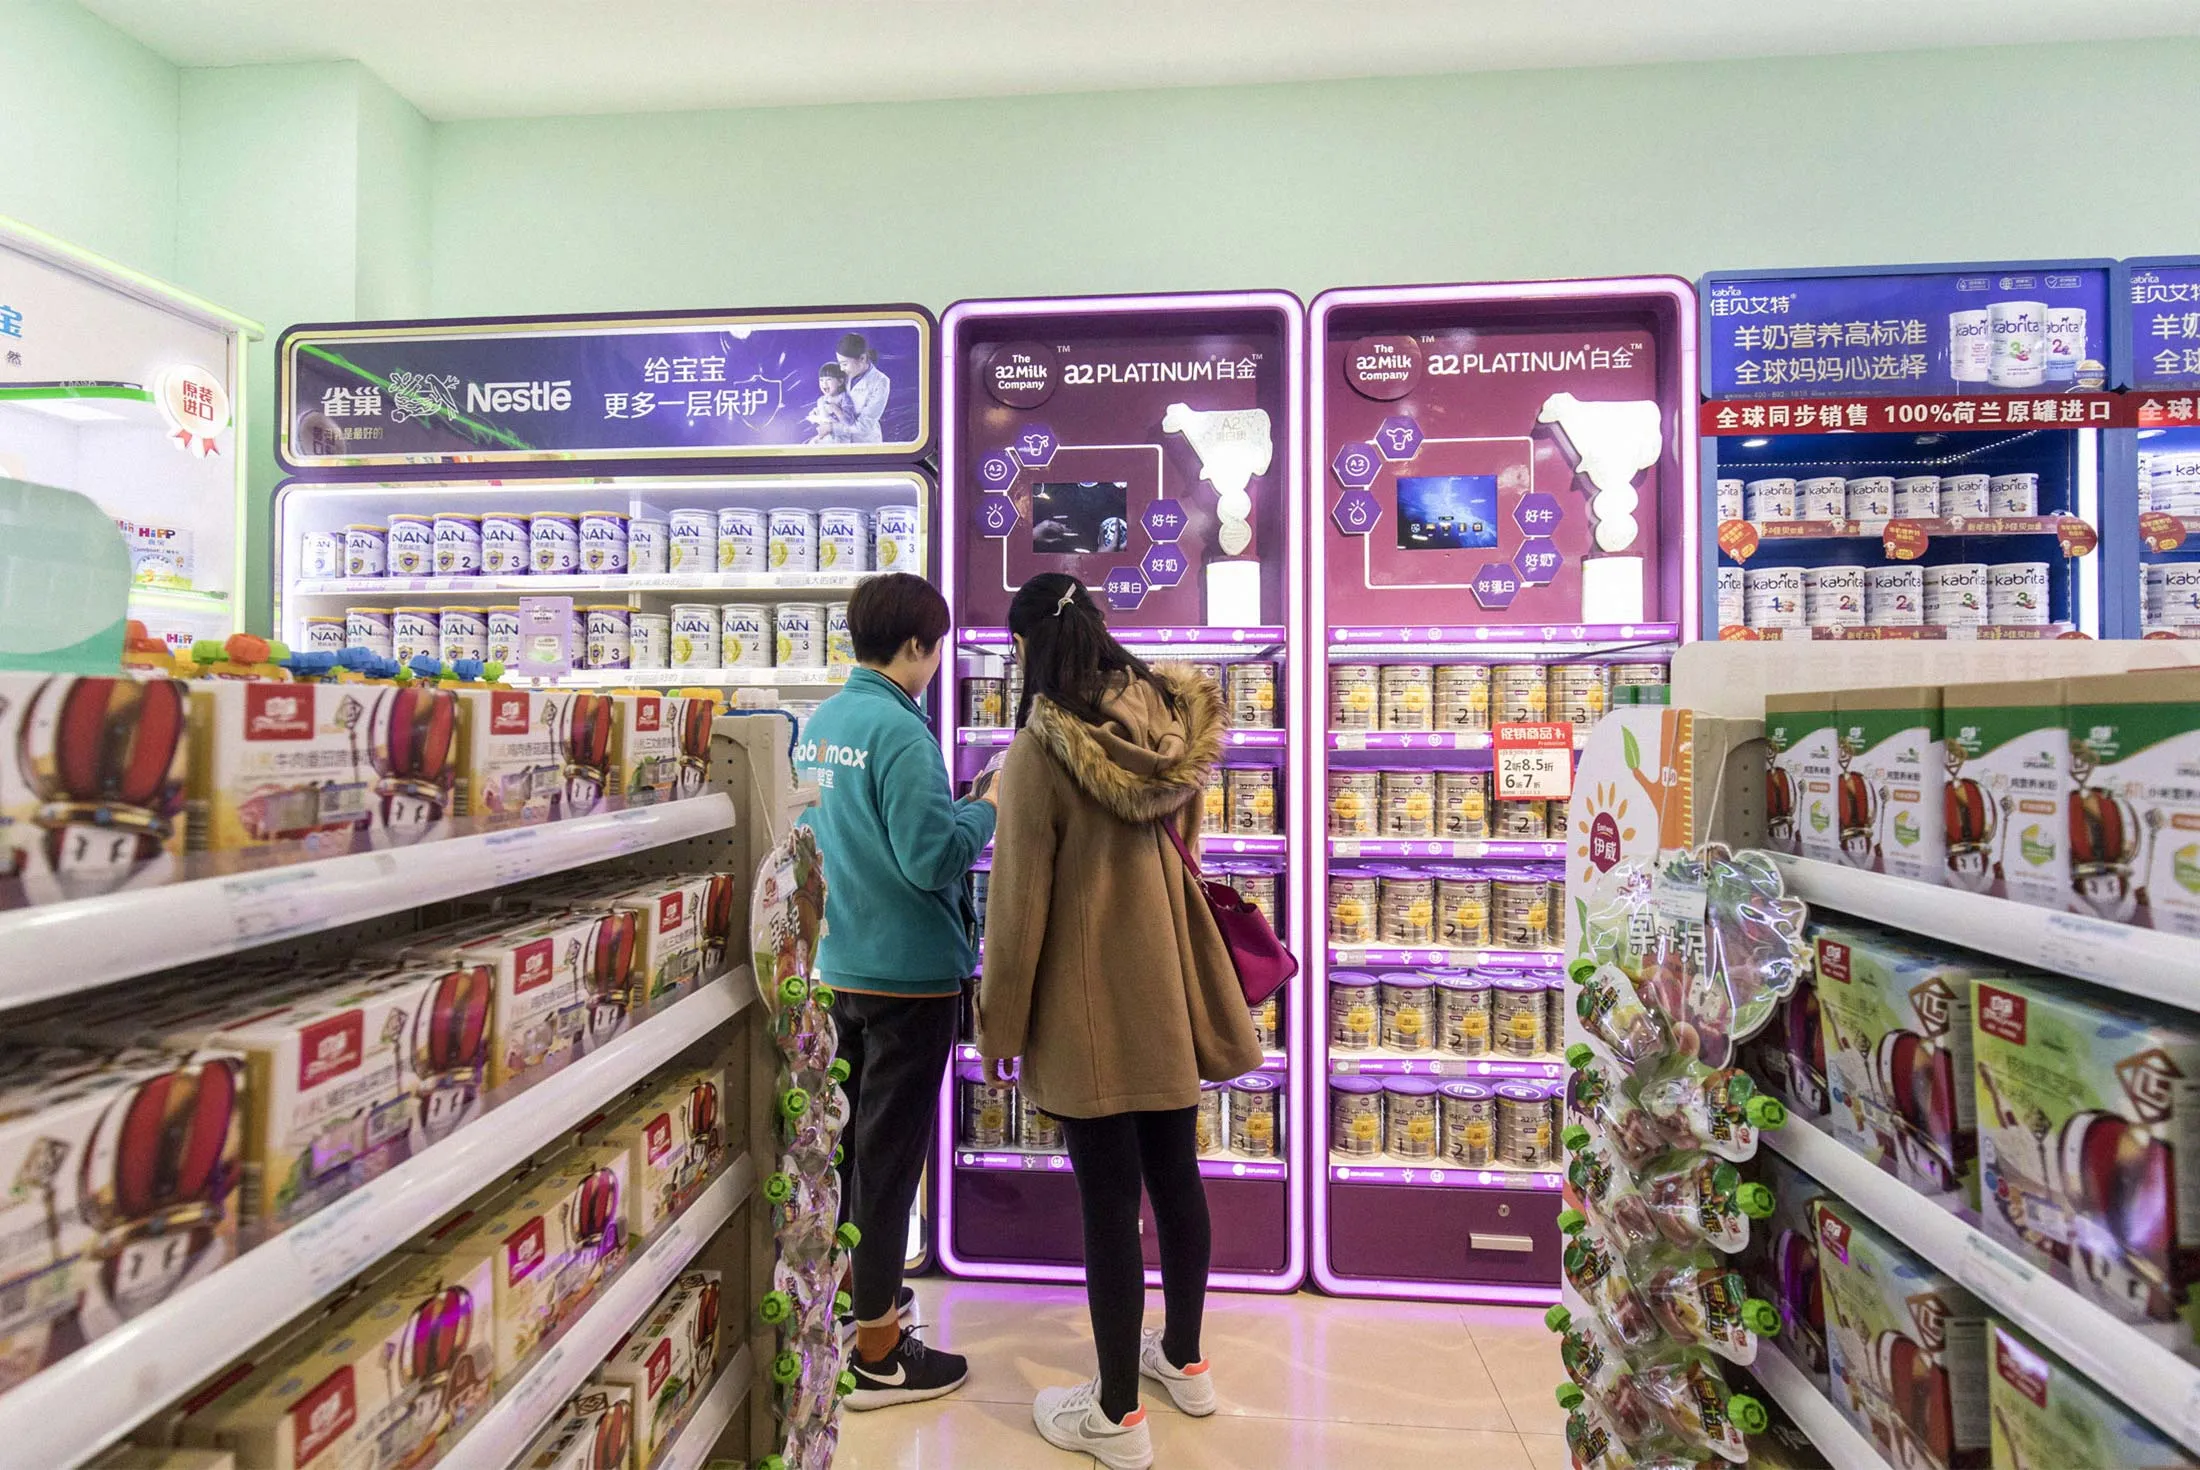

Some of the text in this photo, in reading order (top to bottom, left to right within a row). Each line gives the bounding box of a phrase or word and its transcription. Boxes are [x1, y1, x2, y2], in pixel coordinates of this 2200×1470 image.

[1710, 296, 1790, 316] 佳贝艾特
[1992, 318, 2040, 334] kabrita
[2046, 320, 2079, 334] abrita
[1734, 319, 1928, 351] 羊奶营养高标准
[1374, 343, 1394, 353] The
[2052, 338, 2063, 354] 2
[1012, 354, 1031, 364] The
[644, 356, 727, 384] 给宝宝
[1359, 370, 1409, 381] Company
[1734, 354, 1928, 385] 全球妈妈心选择
[183, 380, 213, 404] 原装
[998, 380, 1045, 391] Company
[320, 387, 382, 417] 雀巢
[467, 380, 572, 414] Nestlé
[603, 388, 768, 420] 更多一层保护
[183, 397, 214, 421] 进口
[1716, 399, 2110, 429] 全球同步销售 100%荷兰原罐进口
[2139, 397, 2200, 421] 全球
[1151, 513, 1178, 527] 好牛
[1525, 508, 1553, 523] 好牛
[720, 523, 752, 536] NAN
[772, 524, 805, 536] NAN
[821, 523, 854, 536] NAN
[881, 522, 914, 534] NAN
[392, 531, 430, 544] NAN
[462, 556, 471, 568] 2
[512, 556, 520, 568] 3
[562, 556, 570, 567] 3
[611, 555, 619, 567] 3
[1151, 558, 1178, 572] 好奶
[1525, 553, 1555, 569] 好奶
[1753, 576, 1799, 590] kabrita
[1995, 572, 2045, 586] kabrita
[1108, 581, 1142, 594] 好蛋白
[1478, 579, 1515, 594] 好蛋白
[1839, 595, 1851, 611] 2
[1896, 595, 1907, 610] 2
[676, 620, 710, 632] NAN
[726, 620, 759, 632] NAN
[778, 619, 809, 631] NAN
[829, 619, 850, 631] NA
[310, 632, 343, 642] NAN
[752, 642, 760, 651] 2
[611, 648, 620, 660] 3
[1457, 708, 1469, 724] 2
[1516, 708, 1528, 723] 2
[1575, 707, 1586, 724] 3
[1501, 727, 1553, 740] 促销商品
[1518, 817, 1529, 833] 2
